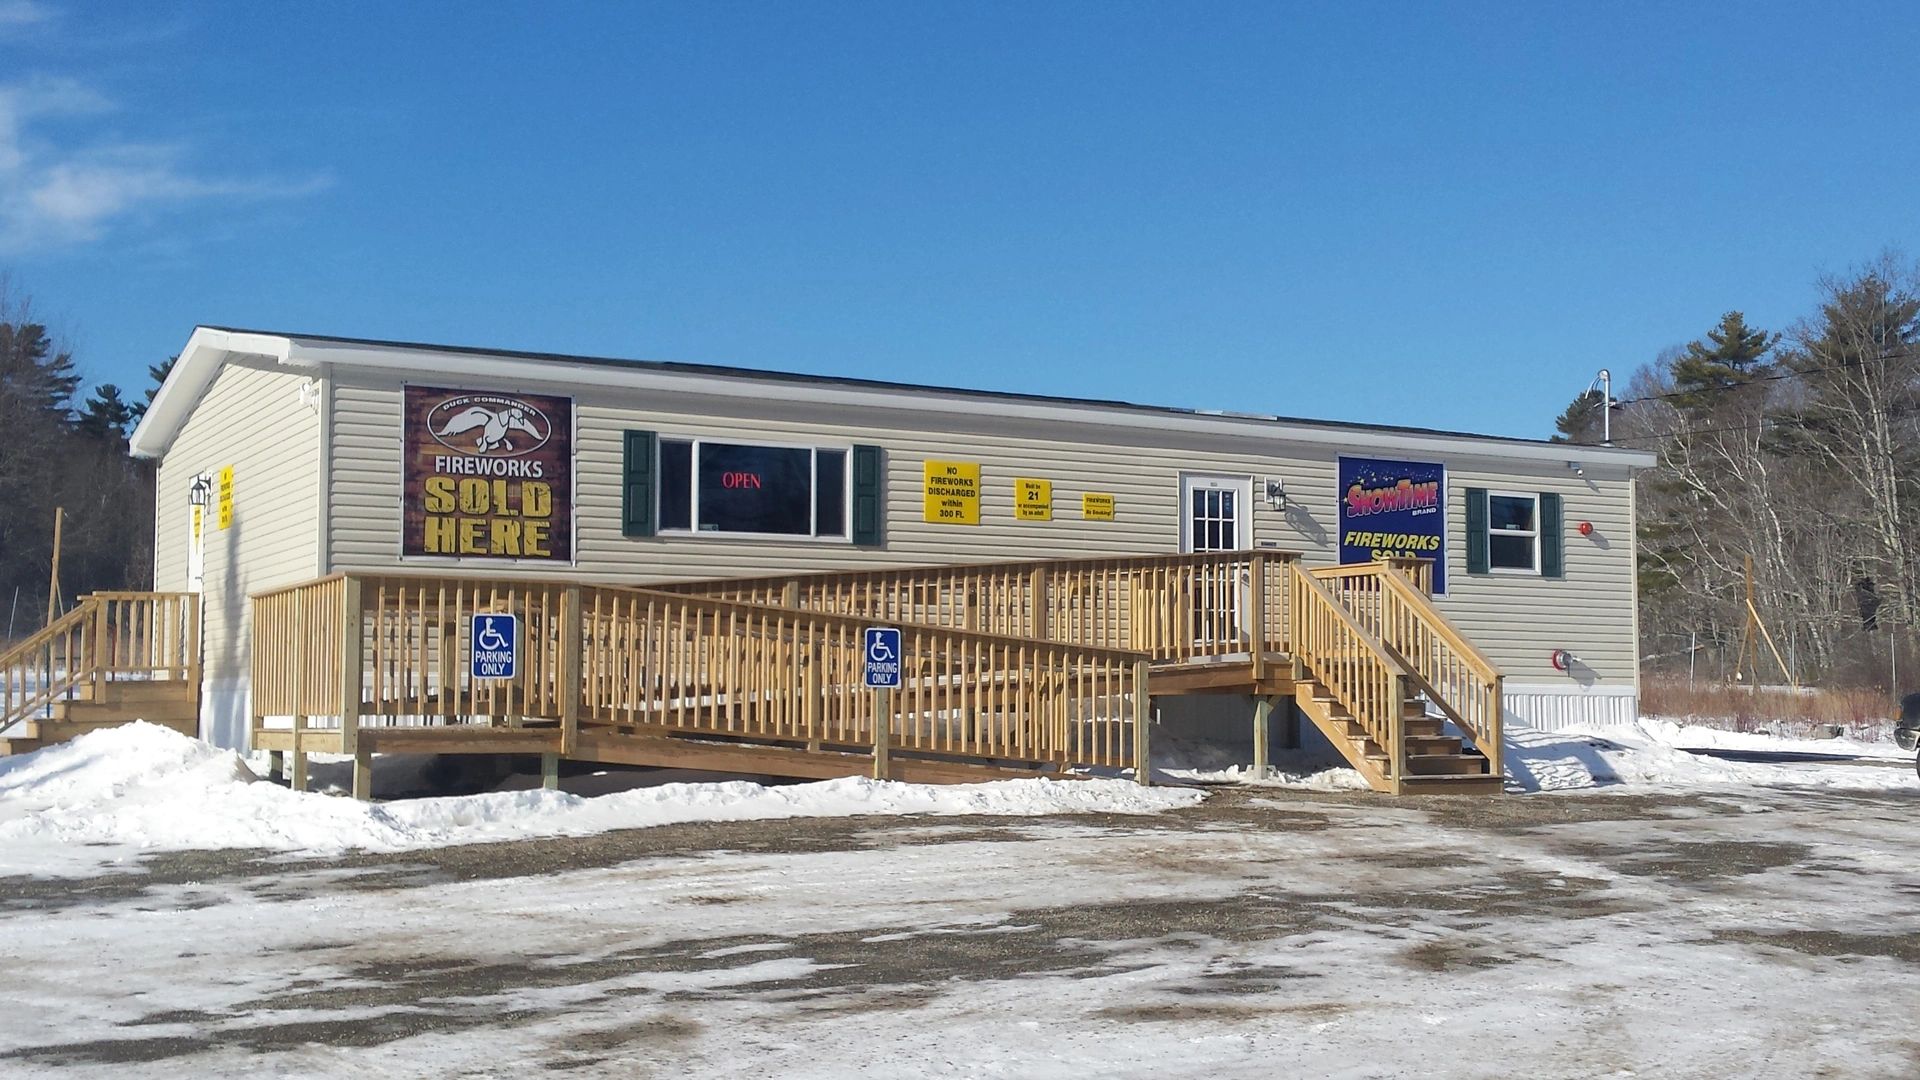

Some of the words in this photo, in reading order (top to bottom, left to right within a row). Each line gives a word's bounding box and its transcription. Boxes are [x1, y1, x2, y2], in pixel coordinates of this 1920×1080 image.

[443, 397, 470, 410] DUCK
[474, 397, 536, 417] COMMANDER
[435, 455, 543, 478] FIREWORKS
[946, 466, 958, 475] NO
[722, 471, 761, 489] OPEN
[930, 477, 974, 487] FIREWORKS
[424, 476, 552, 518] SOLD
[928, 487, 976, 497] DISCHARGED
[1028, 491, 1039, 501] 21
[941, 499, 963, 507] within
[939, 509, 954, 518] 300
[1412, 508, 1436, 516] BRAND
[424, 516, 551, 557] HERE
[1344, 531, 1440, 550] FIREWORKS
[475, 651, 512, 663] PARKING
[481, 663, 505, 675] ONLY
[868, 662, 897, 673] PARKING
[872, 673, 892, 684] ONLY
